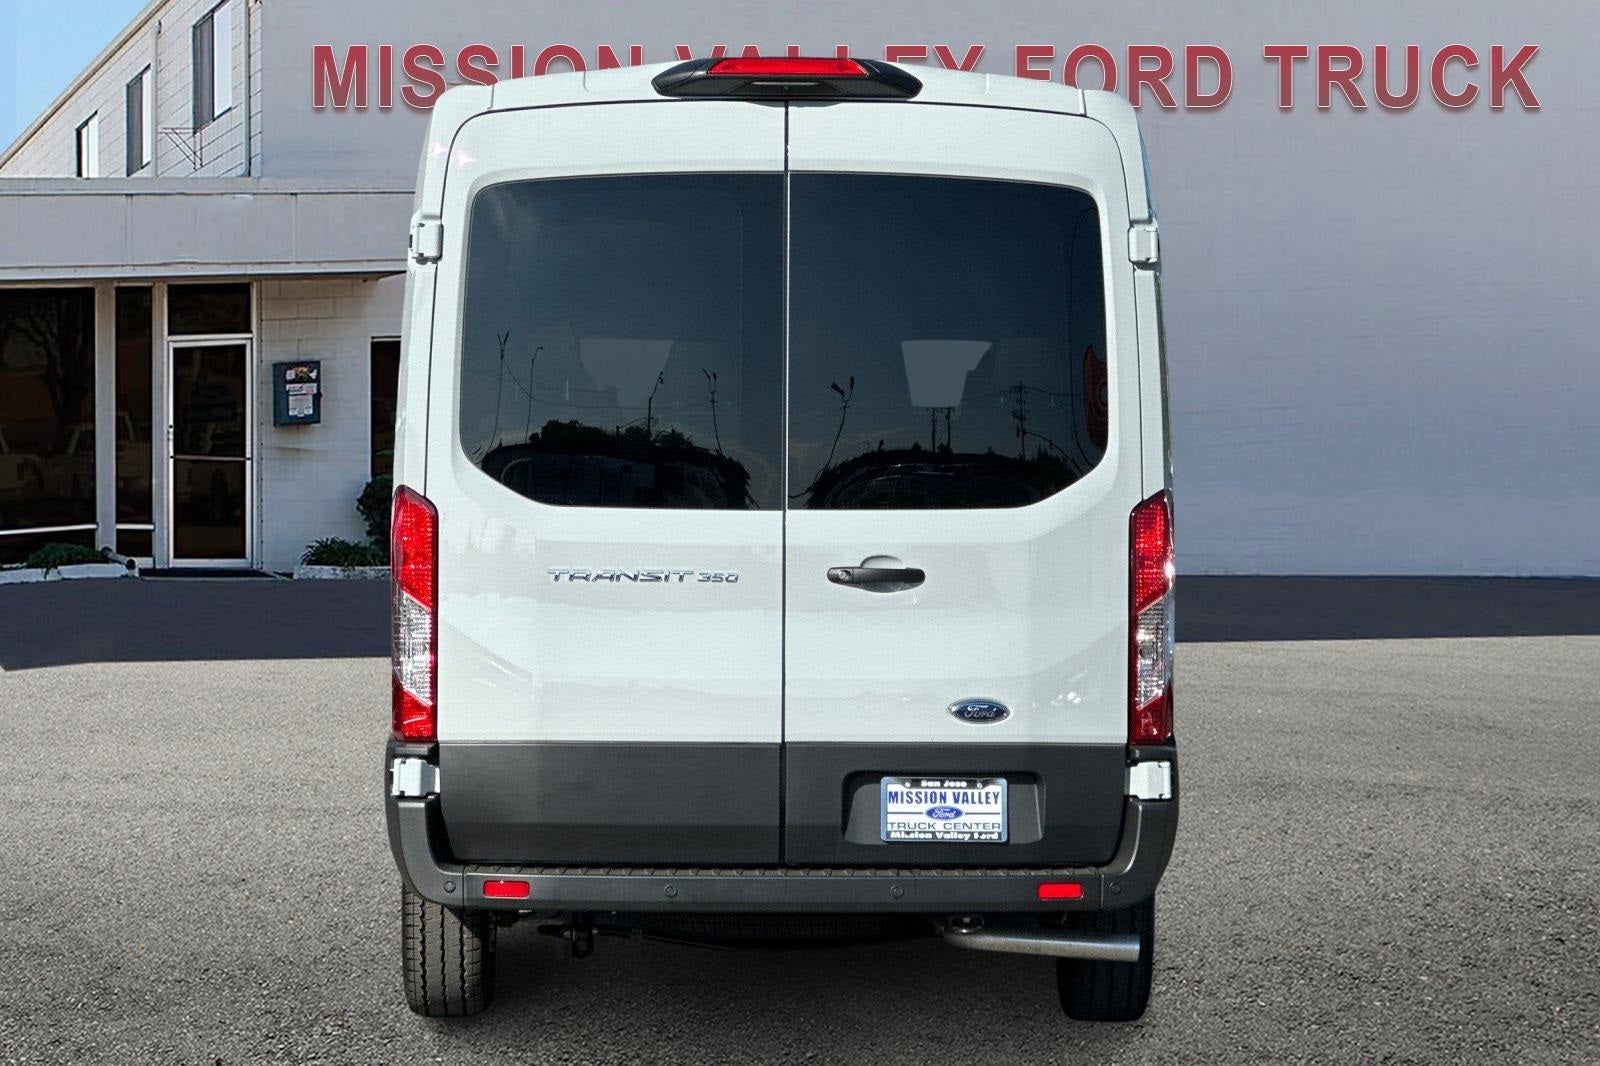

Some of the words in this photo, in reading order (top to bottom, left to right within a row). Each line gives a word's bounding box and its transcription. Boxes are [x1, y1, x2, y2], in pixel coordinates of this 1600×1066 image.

[1262, 44, 1542, 109] TRUCK
[546, 569, 694, 583] TRANSIT
[697, 572, 739, 583] 350
[964, 704, 997, 718] Ford
[920, 780, 941, 788] San
[943, 780, 968, 788] Jose
[888, 791, 947, 805] MISSION
[953, 791, 1000, 805] VALLEY
[932, 807, 956, 818] Ford
[888, 822, 936, 830] TRUCK
[943, 822, 1001, 830] CENTER
[935, 832, 971, 841] Valley
